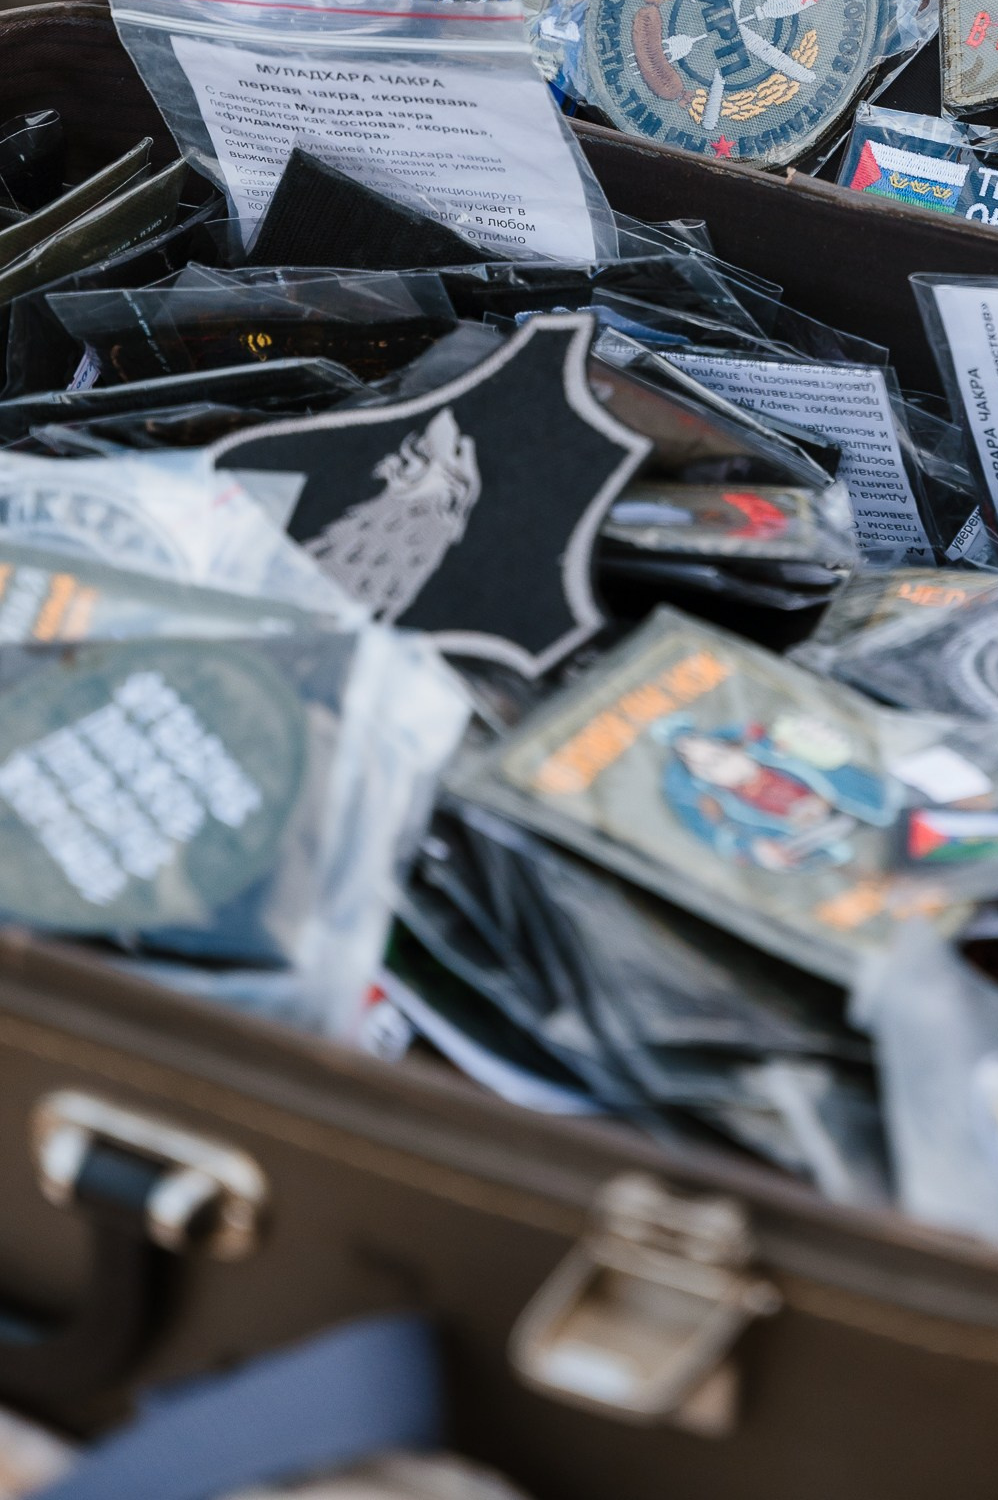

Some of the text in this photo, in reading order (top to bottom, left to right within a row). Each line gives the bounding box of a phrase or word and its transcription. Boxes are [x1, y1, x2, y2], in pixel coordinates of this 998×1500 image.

[966, 11, 989, 48] В
[256, 63, 446, 89] МУЛАДХАРА ЧАКРА
[238, 79, 478, 108] первая чакра, «корневая»
[210, 98, 299, 123] переводится
[303, 116, 327, 125] как
[219, 91, 291, 110] санскрита
[294, 103, 383, 119] Муладхара
[388, 111, 433, 121] чакра
[220, 125, 290, 145] Основной
[369, 146, 453, 161] Муладхара
[457, 153, 502, 164] чакры
[229, 151, 286, 165] выжива
[234, 165, 276, 177] Когда
[390, 159, 434, 168] жизни
[453, 163, 506, 174] умение
[518, 208, 526, 216] в
[476, 216, 483, 225] в
[487, 218, 536, 232] любом
[467, 230, 526, 244] отлично
[728, 384, 880, 406] противопоставление
[968, 367, 995, 423] ЧАКРА
[760, 401, 801, 414] чакру
[804, 406, 884, 422] Блокируют
[838, 440, 892, 452] мышле
[851, 479, 904, 491] память
[860, 491, 908, 505] Аджна
[857, 510, 914, 521] зависит
